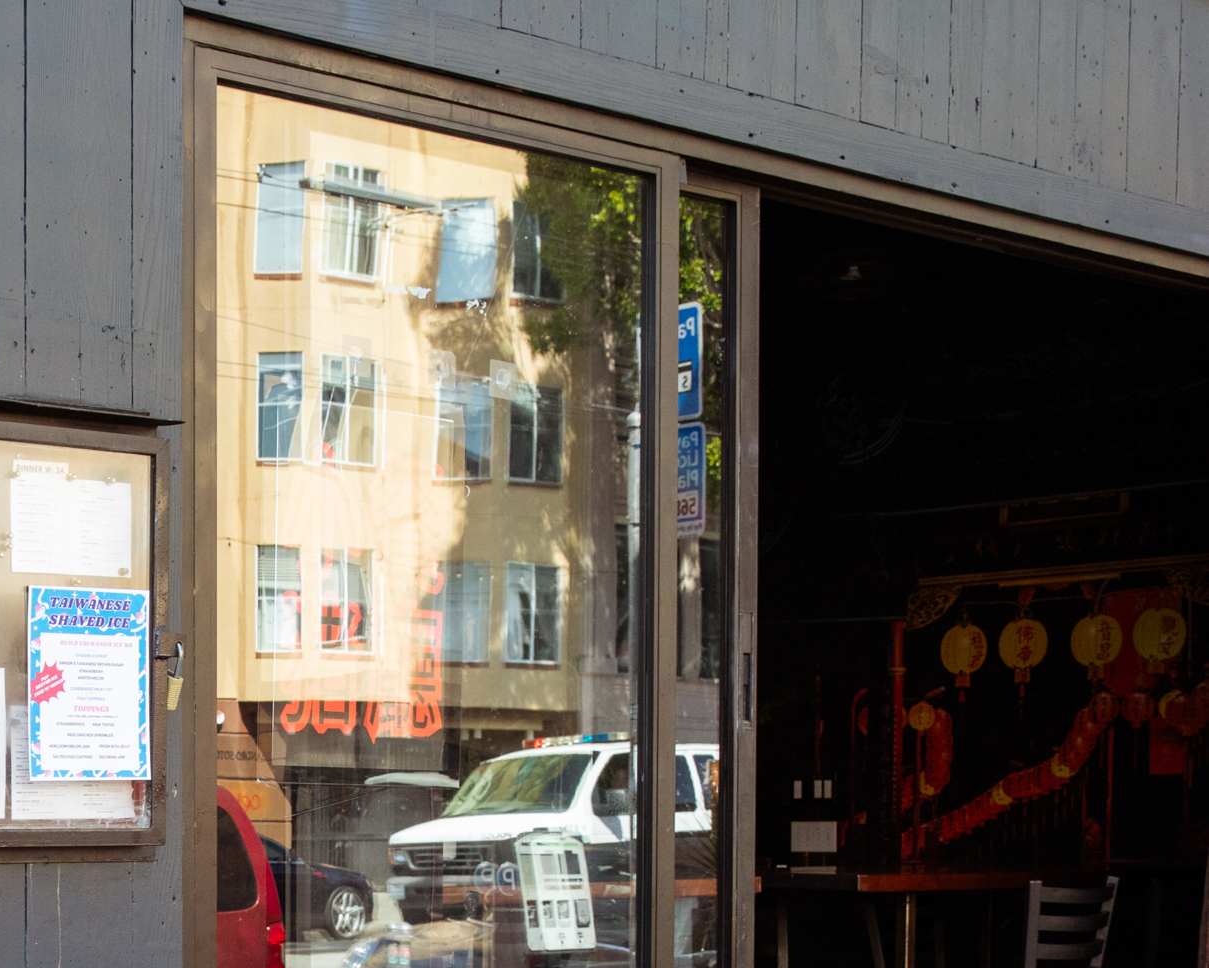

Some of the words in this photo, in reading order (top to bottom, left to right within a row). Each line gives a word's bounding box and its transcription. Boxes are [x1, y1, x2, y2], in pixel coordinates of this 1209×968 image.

[16, 464, 42, 473] DINNER
[50, 597, 131, 611] TAIWANESE
[48, 614, 105, 628] SHAVED
[108, 617, 131, 629] ICE
